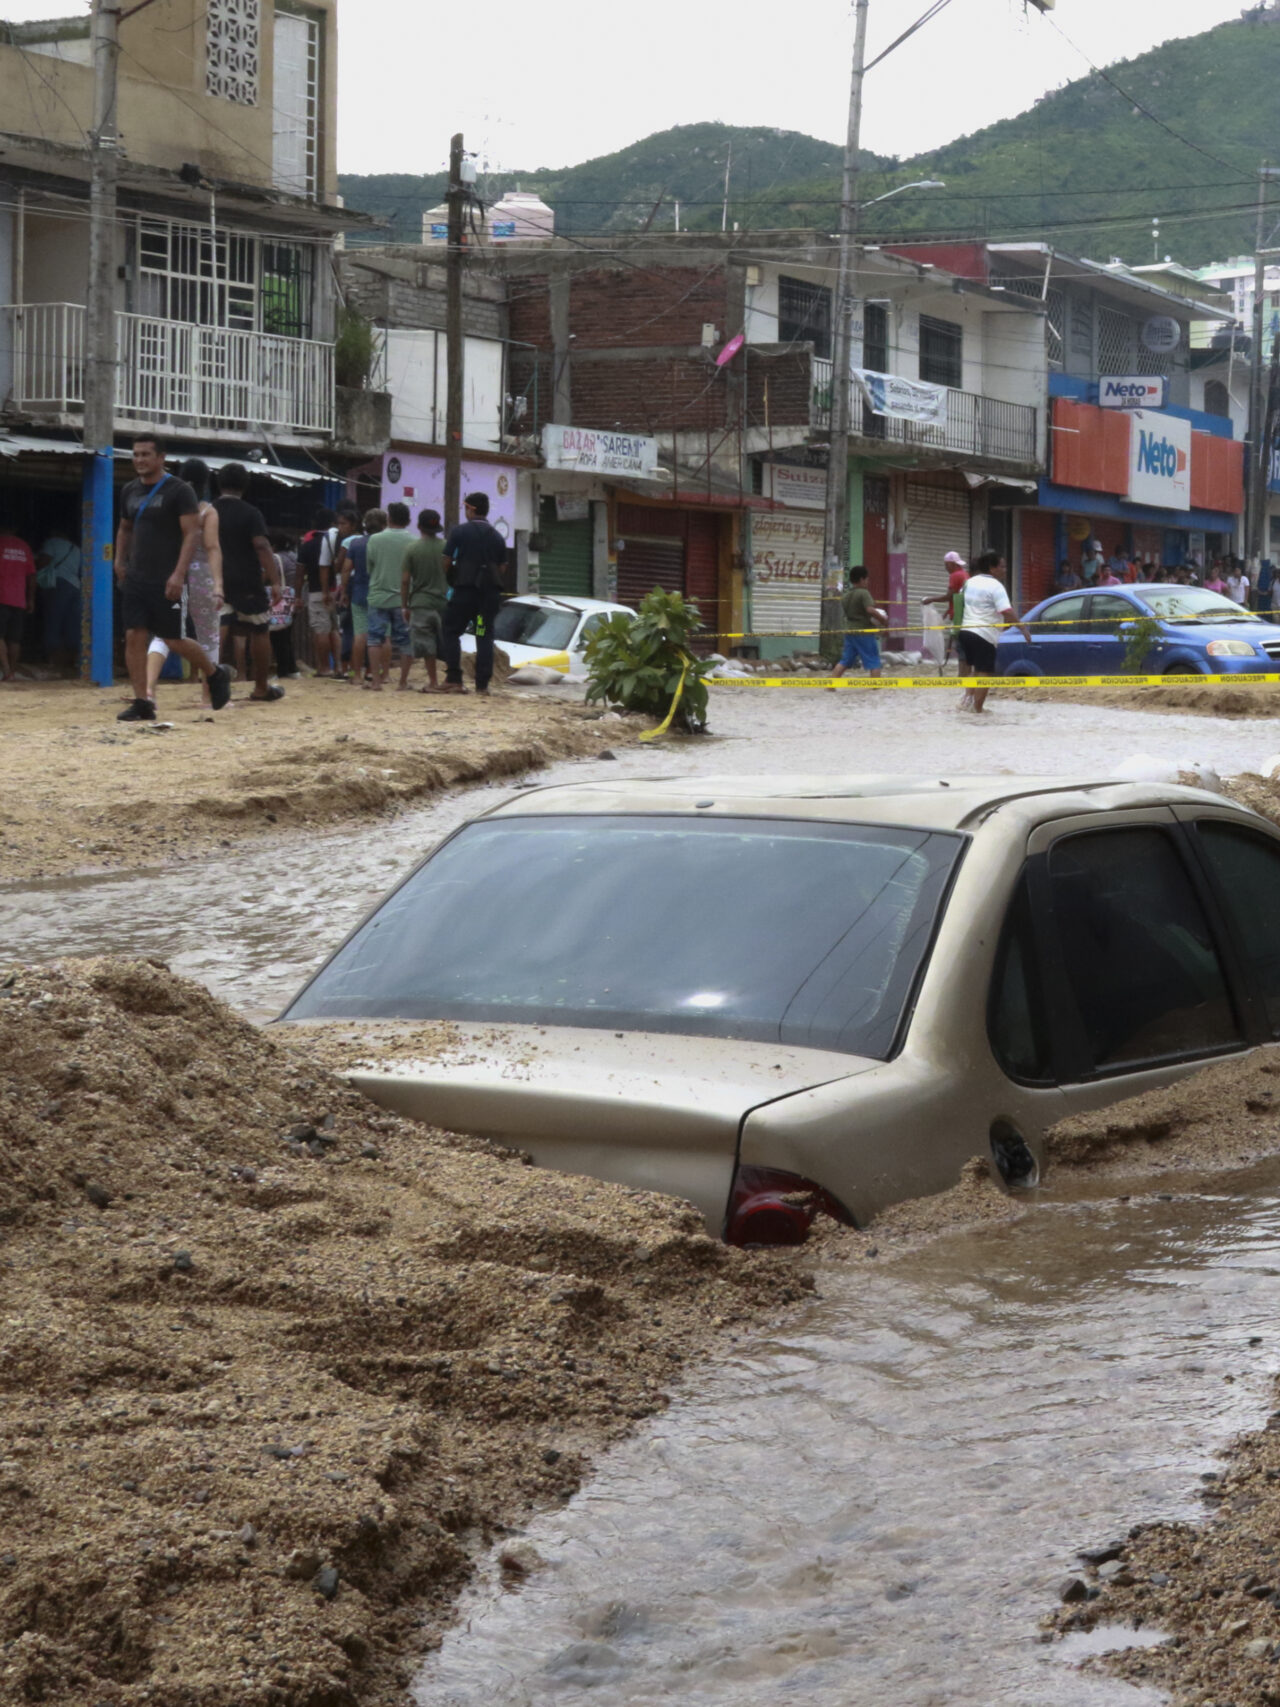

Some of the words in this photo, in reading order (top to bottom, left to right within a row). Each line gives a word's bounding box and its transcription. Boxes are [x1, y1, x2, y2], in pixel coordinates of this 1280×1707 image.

[1105, 382, 1146, 397] Neto
[563, 430, 596, 452] BAZAR
[1137, 429, 1177, 478] Neto
